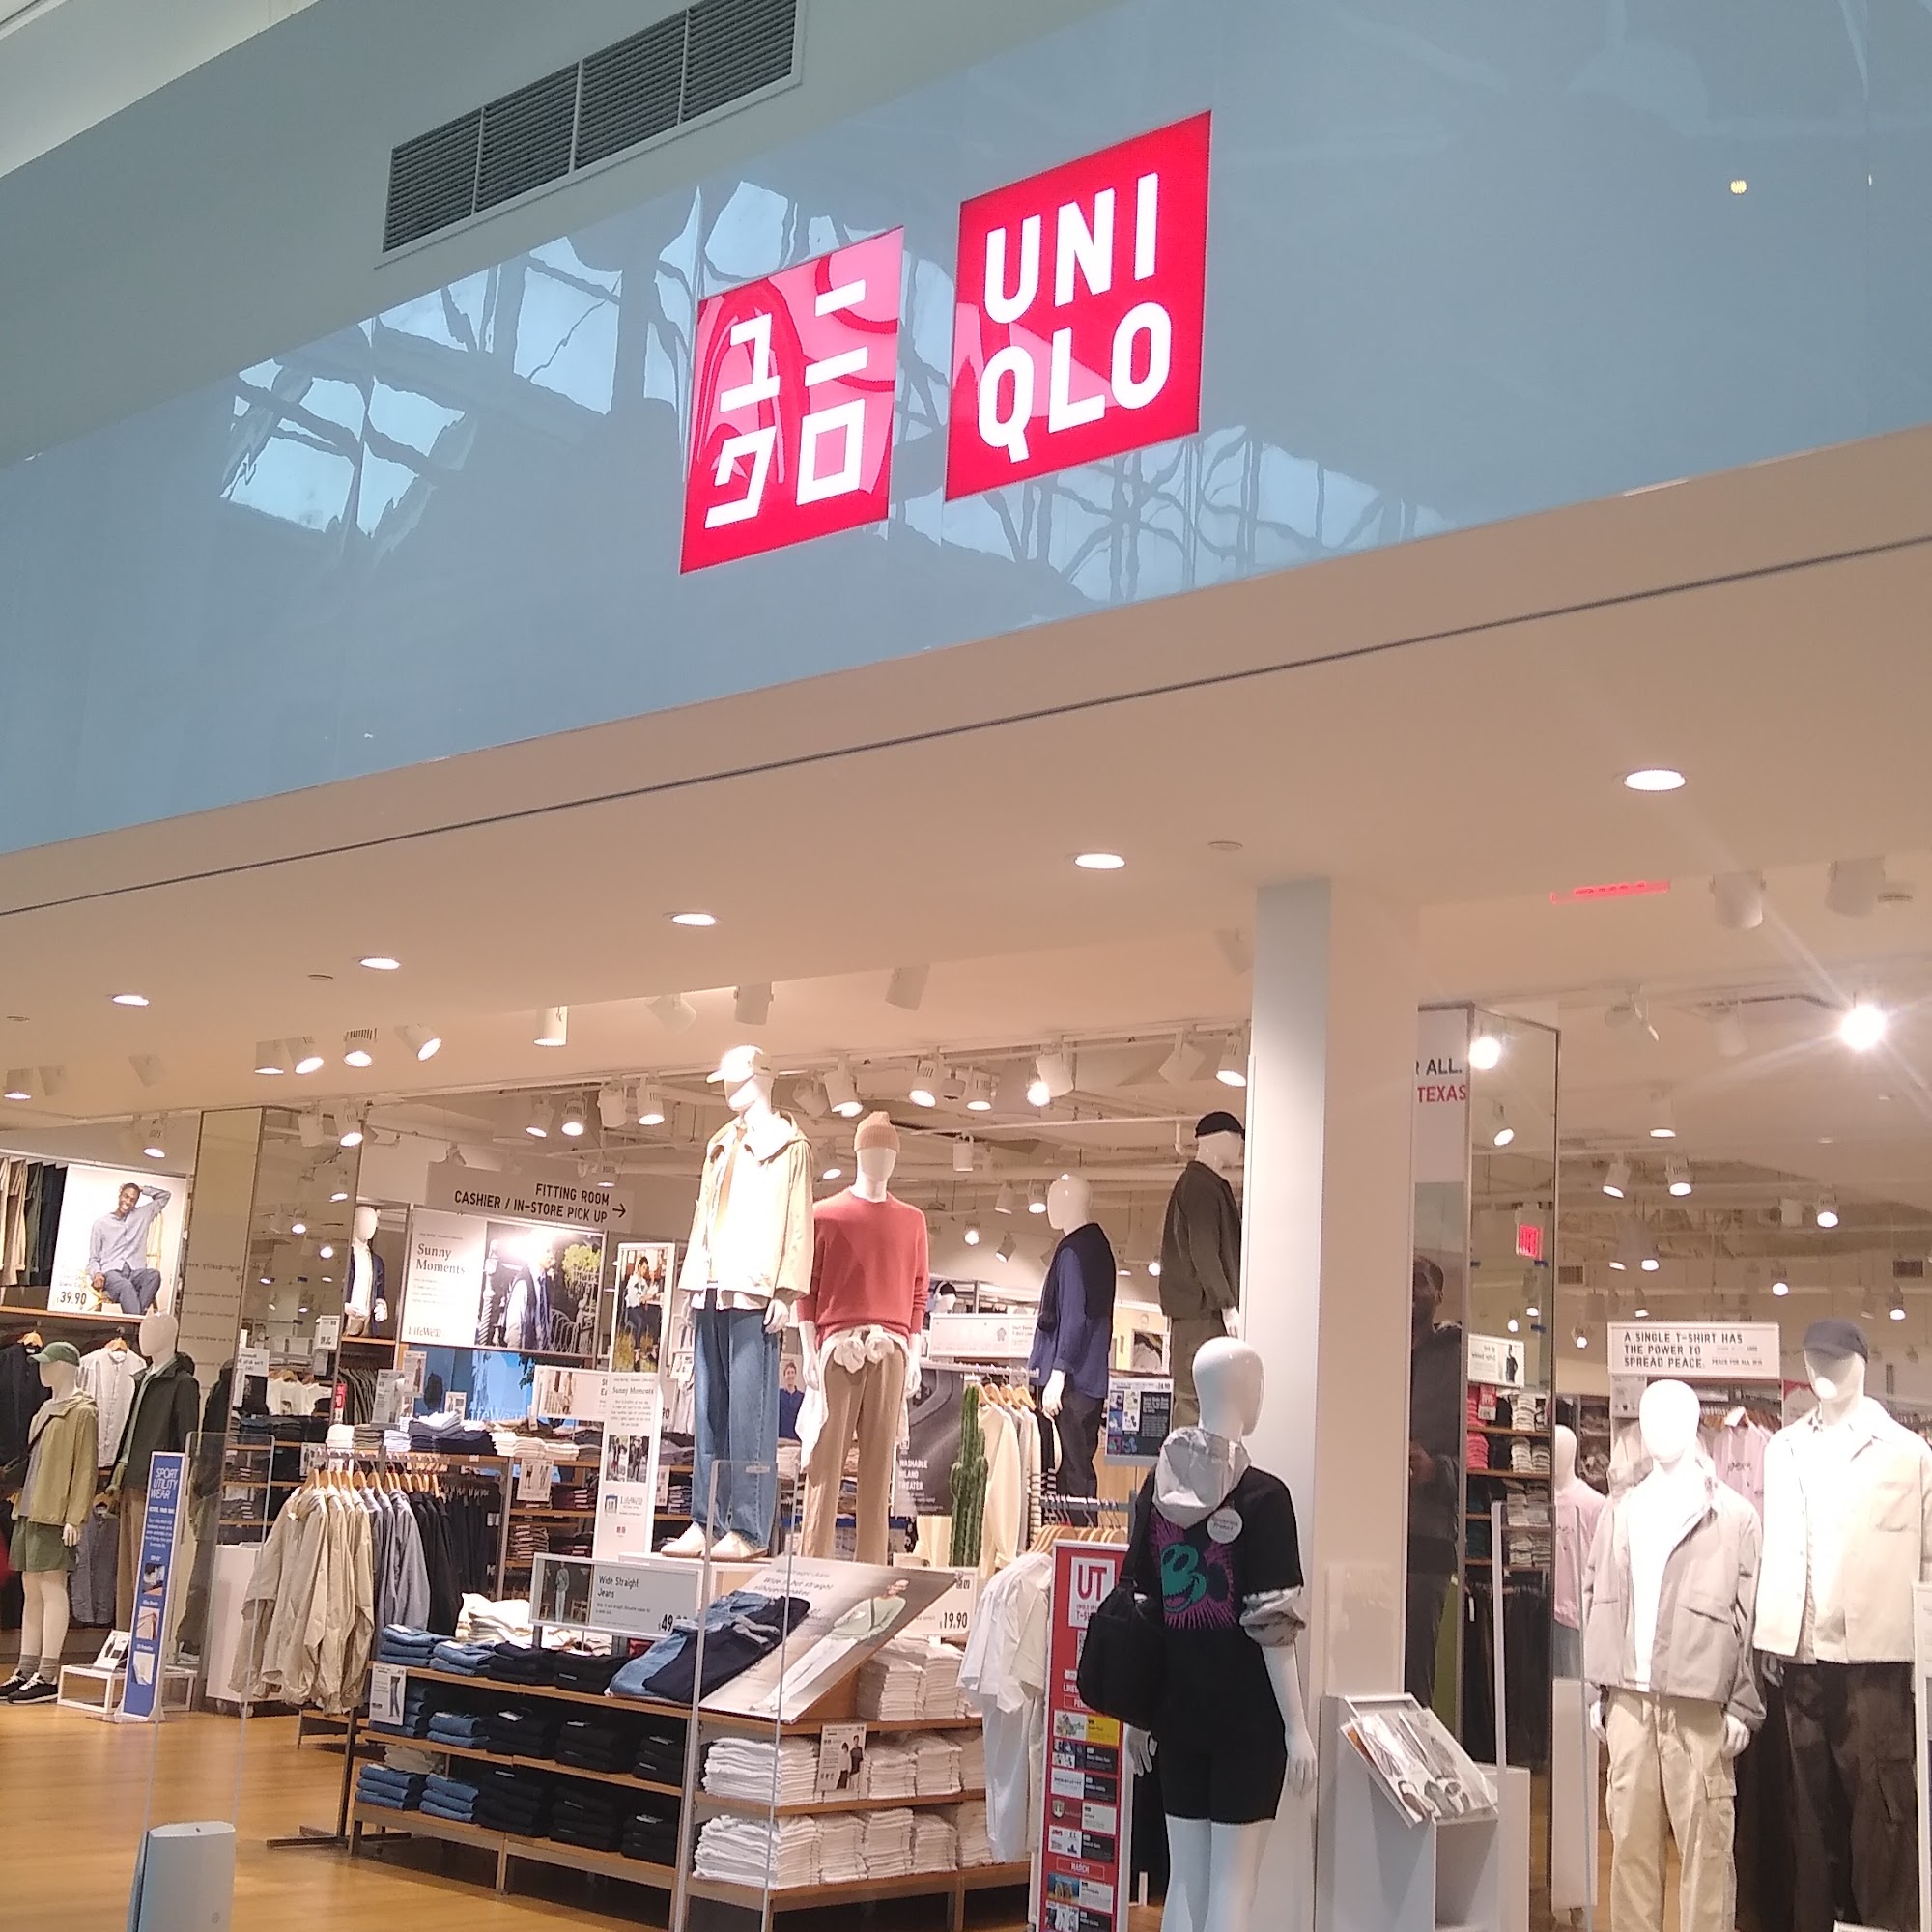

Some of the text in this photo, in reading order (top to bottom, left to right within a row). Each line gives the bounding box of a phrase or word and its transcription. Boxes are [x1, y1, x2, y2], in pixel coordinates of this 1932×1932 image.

[983, 172, 1158, 325] UNI
[978, 301, 1173, 464] QLO
[1417, 1084, 1466, 1103] TEXAS
[535, 1182, 610, 1206] FITTING ROOM
[454, 1190, 501, 1208] CASHIER
[513, 1198, 563, 1217] IN-STORE
[567, 1207, 589, 1221] PICK
[594, 1209, 608, 1223] UP
[417, 1243, 451, 1260] Sunny
[415, 1258, 465, 1275] Moments
[1624, 1331, 1743, 1344] A SINGLE T-SHIRT HAS
[1624, 1345, 1701, 1355] THE POWER TO
[1624, 1356, 1663, 1368] SPREAD
[898, 1459, 927, 1468] WASHABLE
[155, 1467, 179, 1478] SPORT
[153, 1478, 178, 1490] UTILITY
[150, 1488, 171, 1499] WEAR
[599, 1575, 639, 1590] Wide Straight
[1077, 1564, 1108, 1602] UT
[597, 1588, 614, 1599] Jeans
